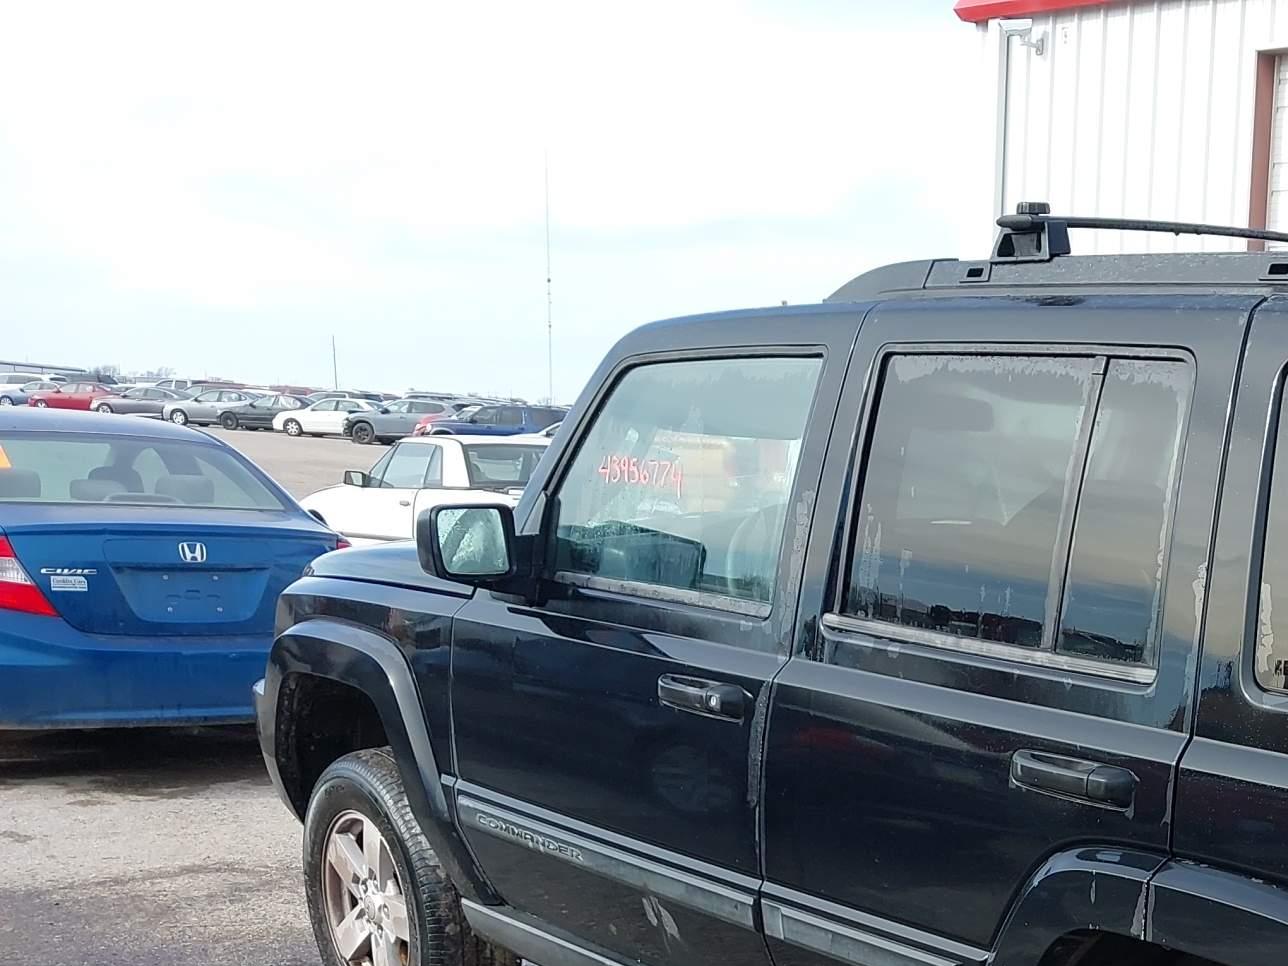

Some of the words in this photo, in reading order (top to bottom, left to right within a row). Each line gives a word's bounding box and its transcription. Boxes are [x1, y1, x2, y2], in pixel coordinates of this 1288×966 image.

[598, 455, 682, 499] 43956774
[40, 567, 98, 576] CIVIC
[476, 812, 584, 861] COMMANDER
